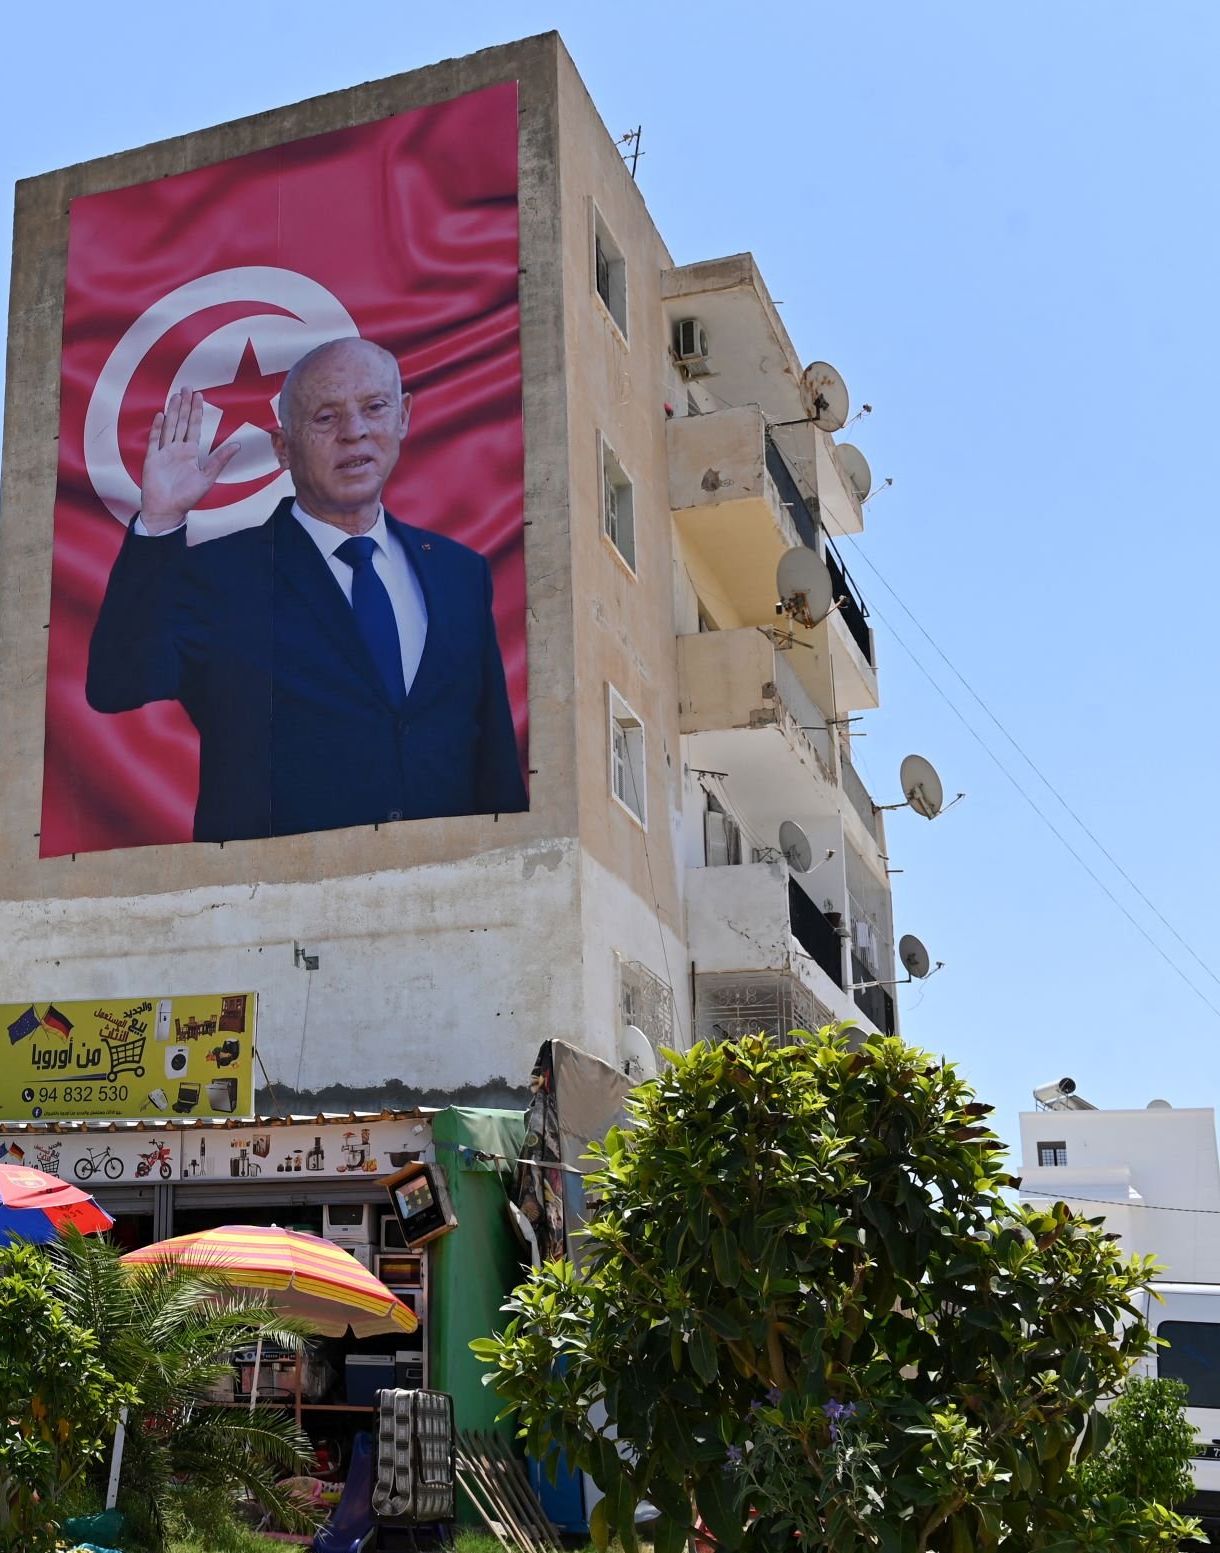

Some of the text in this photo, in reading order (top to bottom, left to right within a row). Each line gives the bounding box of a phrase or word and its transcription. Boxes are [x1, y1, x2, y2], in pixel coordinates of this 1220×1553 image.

[94, 1008, 127, 1028] المستعمل
[123, 1001, 152, 1019] والجديد
[128, 1018, 148, 1037] بيع
[31, 1036, 102, 1070] من أوروبا
[39, 1085, 128, 1103] 94 832 530
